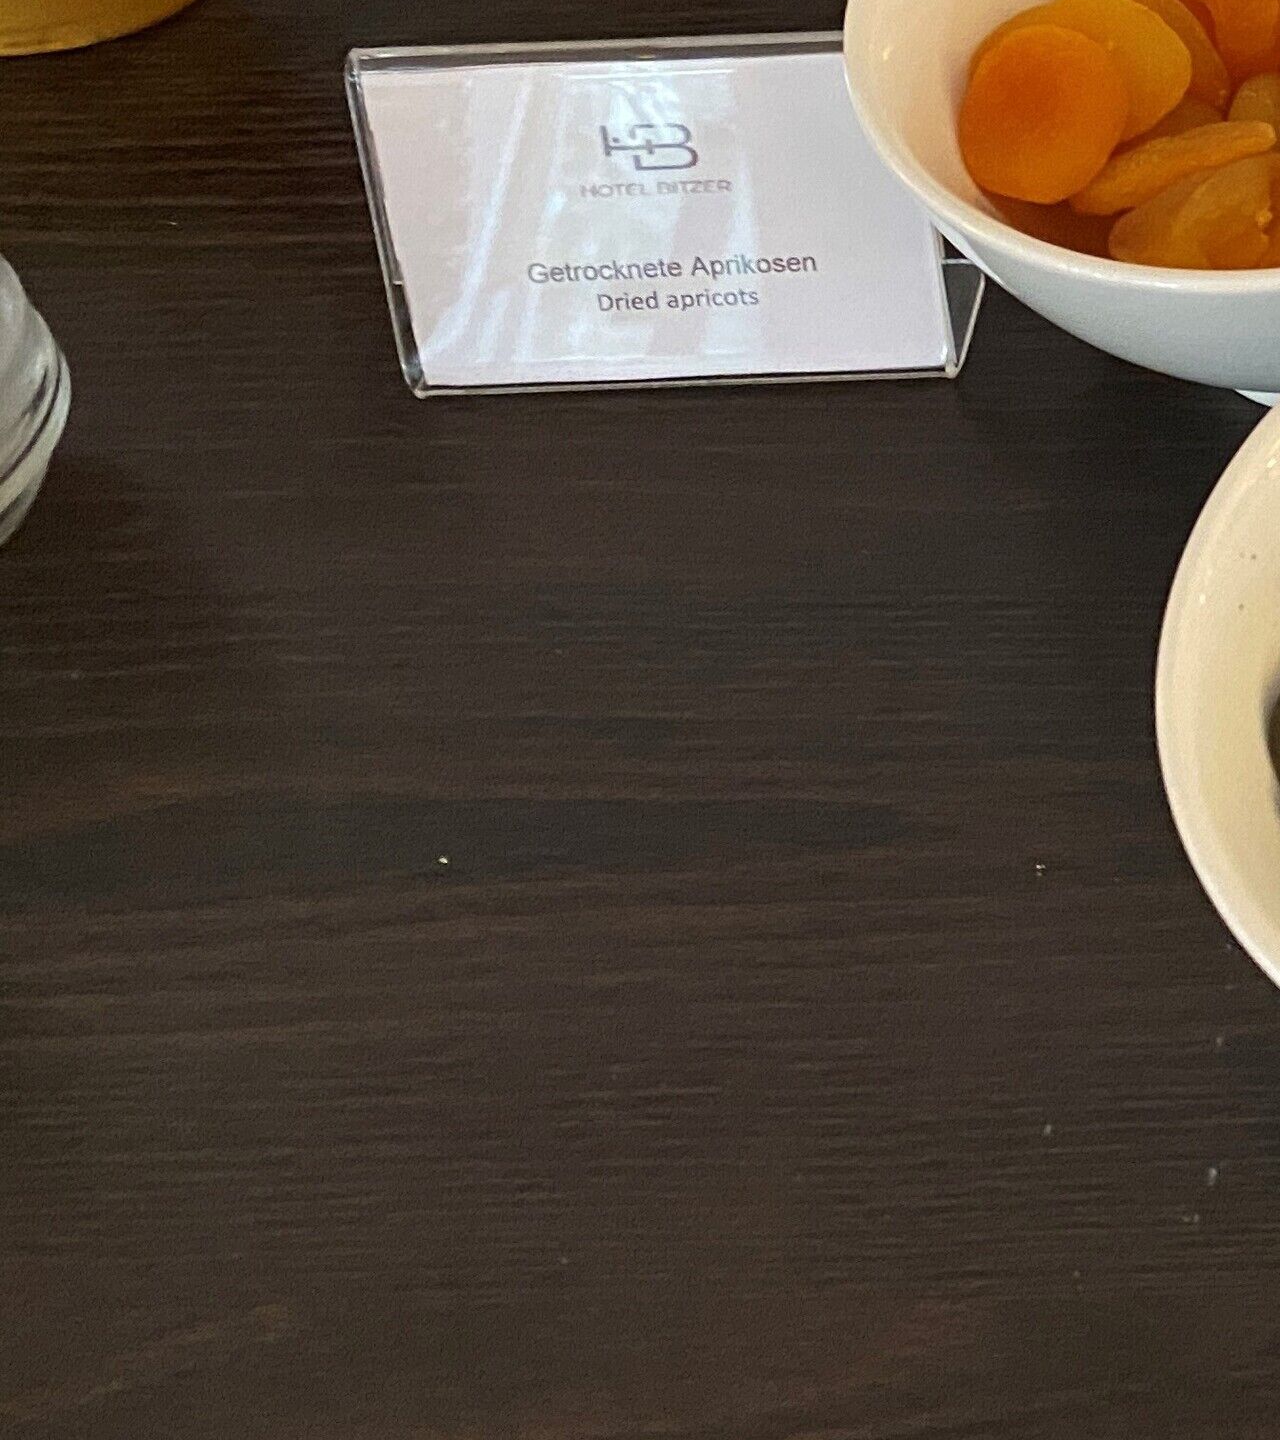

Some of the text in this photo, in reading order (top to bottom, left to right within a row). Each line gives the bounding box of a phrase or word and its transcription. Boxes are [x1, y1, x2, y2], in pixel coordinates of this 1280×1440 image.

[580, 179, 734, 198] HOTEL BITZER
[527, 253, 818, 285] Getrocknete Aprikosen
[597, 288, 760, 313] Dried apricots
